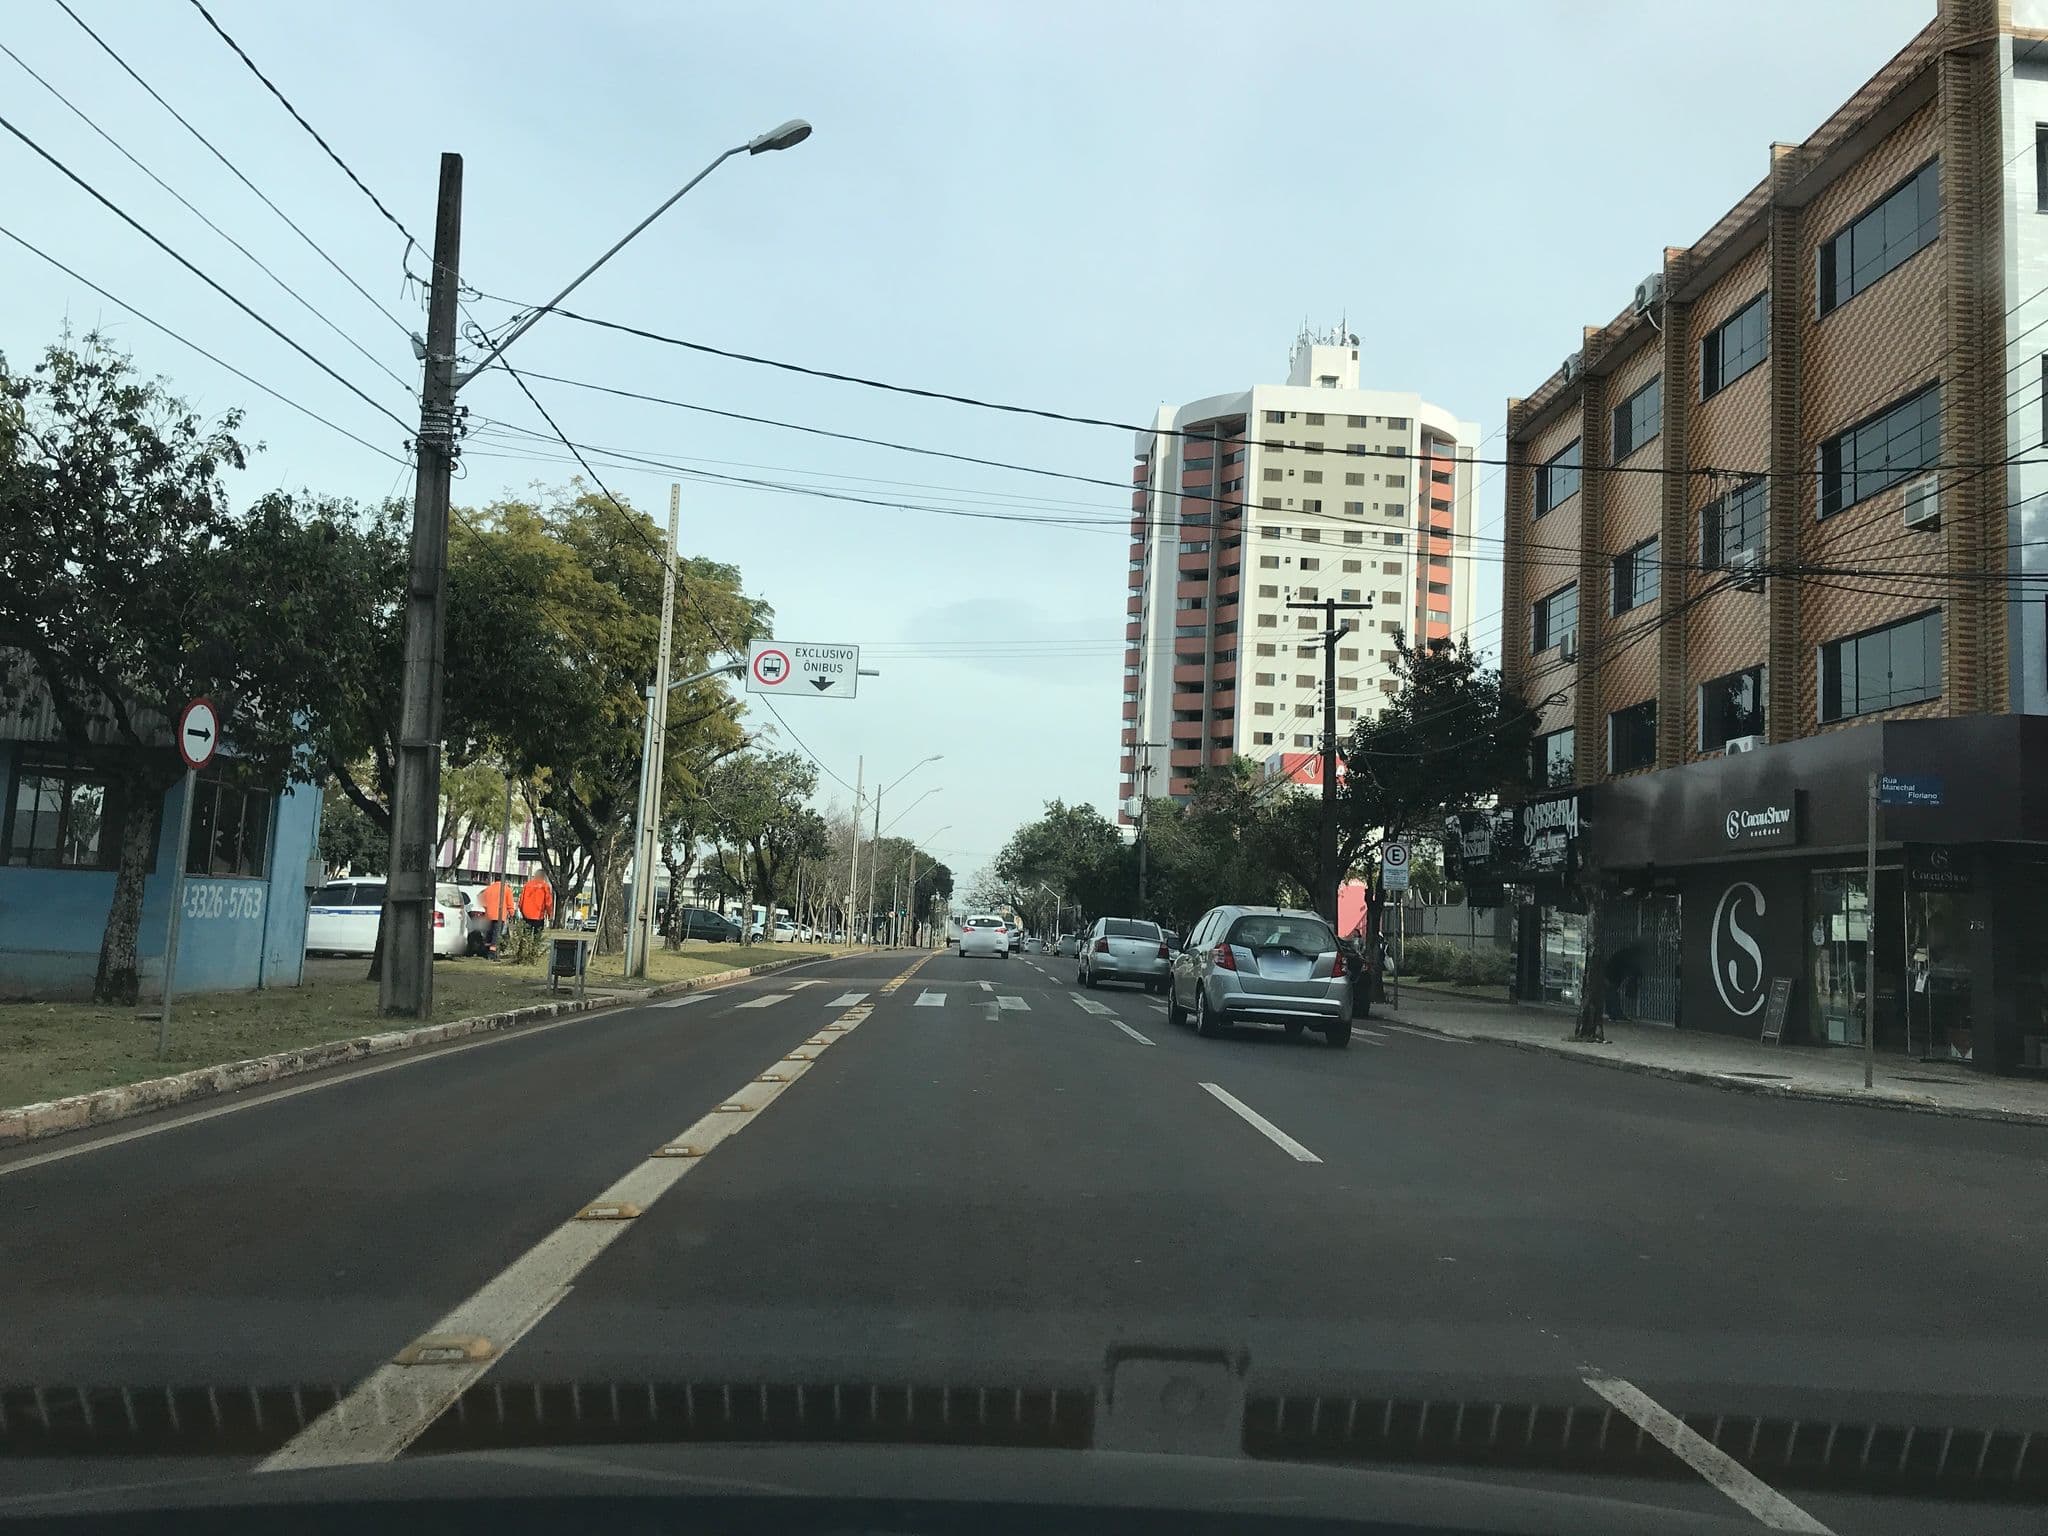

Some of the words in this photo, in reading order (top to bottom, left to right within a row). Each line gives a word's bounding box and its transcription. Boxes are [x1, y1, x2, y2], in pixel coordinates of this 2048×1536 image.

[795, 648, 853, 660] EXCLUSIVO
[803, 660, 843, 673] ÔNIBUS
[1523, 796, 1579, 846] BARBEARIA
[1392, 849, 1400, 861] E
